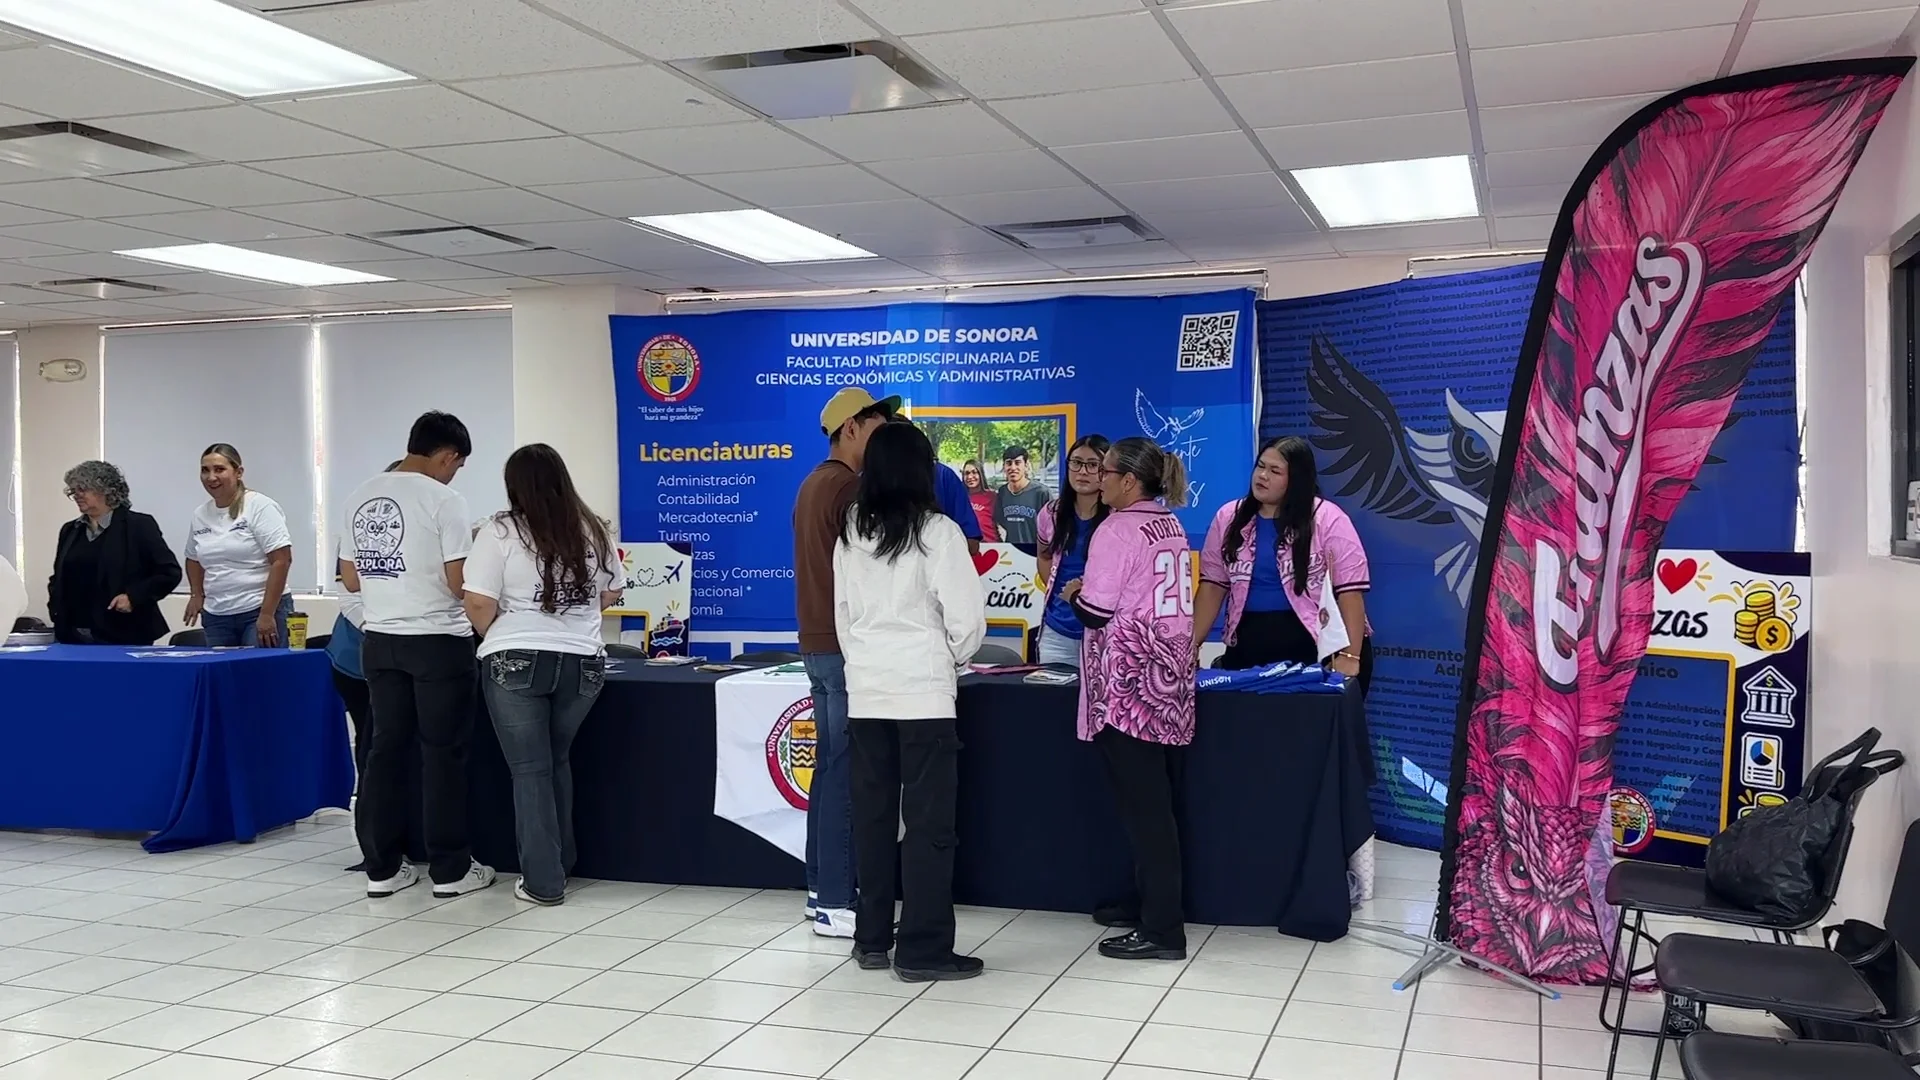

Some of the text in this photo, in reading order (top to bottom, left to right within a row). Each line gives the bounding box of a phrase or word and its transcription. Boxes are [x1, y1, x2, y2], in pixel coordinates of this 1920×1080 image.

[1458, 273, 1509, 287] Licenciatura
[1511, 270, 1522, 280] en
[1431, 287, 1494, 302] Internacionales
[1397, 302, 1458, 317] Internacionales
[1458, 295, 1509, 311] Licenciatura
[1431, 309, 1494, 325] Internacionales
[790, 326, 1039, 348] UNIVERSIDAD DE SONORA
[1397, 325, 1458, 340] Internacionales
[1458, 318, 1509, 334] Licenciatura
[1431, 331, 1494, 348] Internacionales
[786, 350, 1040, 369] FACULTAD INTERDISCIPLINARIA DE
[1397, 347, 1458, 362] Internacionales
[1459, 342, 1509, 357] Licenciatura
[1377, 361, 1435, 375] Internacionales
[1436, 355, 1486, 370] Licenciatura
[1487, 357, 1499, 366] en
[1442, 365, 1491, 381] Licenciatura
[755, 365, 1076, 386] CIENCIAS ECONÓMICAS Y ADMINISTRATIVAS
[1466, 382, 1504, 394] Comercio
[666, 405, 675, 413] de
[675, 404, 688, 413] mis
[639, 440, 794, 462] Licenciaturas
[657, 472, 756, 487] Administración
[657, 491, 740, 505] Contabilidad
[658, 529, 711, 542] Turismo
[358, 550, 381, 559] FERIA
[691, 550, 716, 561] zas
[692, 566, 796, 581] cios y Comercio
[690, 585, 744, 597] nacional
[985, 585, 1033, 609] ción
[691, 604, 724, 616] omía
[1650, 609, 1709, 639] zas
[1372, 645, 1464, 662] partamento
[1637, 661, 1679, 679] nico
[1198, 675, 1232, 689] UNISON
[1630, 699, 1721, 717] en Administración
[767, 698, 810, 752] UNIVERSIDAD
[1632, 712, 1645, 721] en
[1646, 711, 1692, 726] Negocios
[1702, 718, 1726, 729] Com
[1632, 725, 1722, 744] en Administración
[1631, 738, 1645, 747] en
[1646, 738, 1692, 752] Negocios
[1701, 744, 1725, 756] Com
[1631, 750, 1720, 769] en Administración
[1627, 764, 1641, 773] en
[1642, 764, 1690, 779] Negocios
[1697, 773, 1721, 784] Com
[1629, 778, 1689, 793] Licenciatura
[1690, 786, 1704, 795] en
[1647, 793, 1661, 802] en
[1661, 793, 1710, 809] Negocios
[1654, 807, 1704, 821] ciatura en
